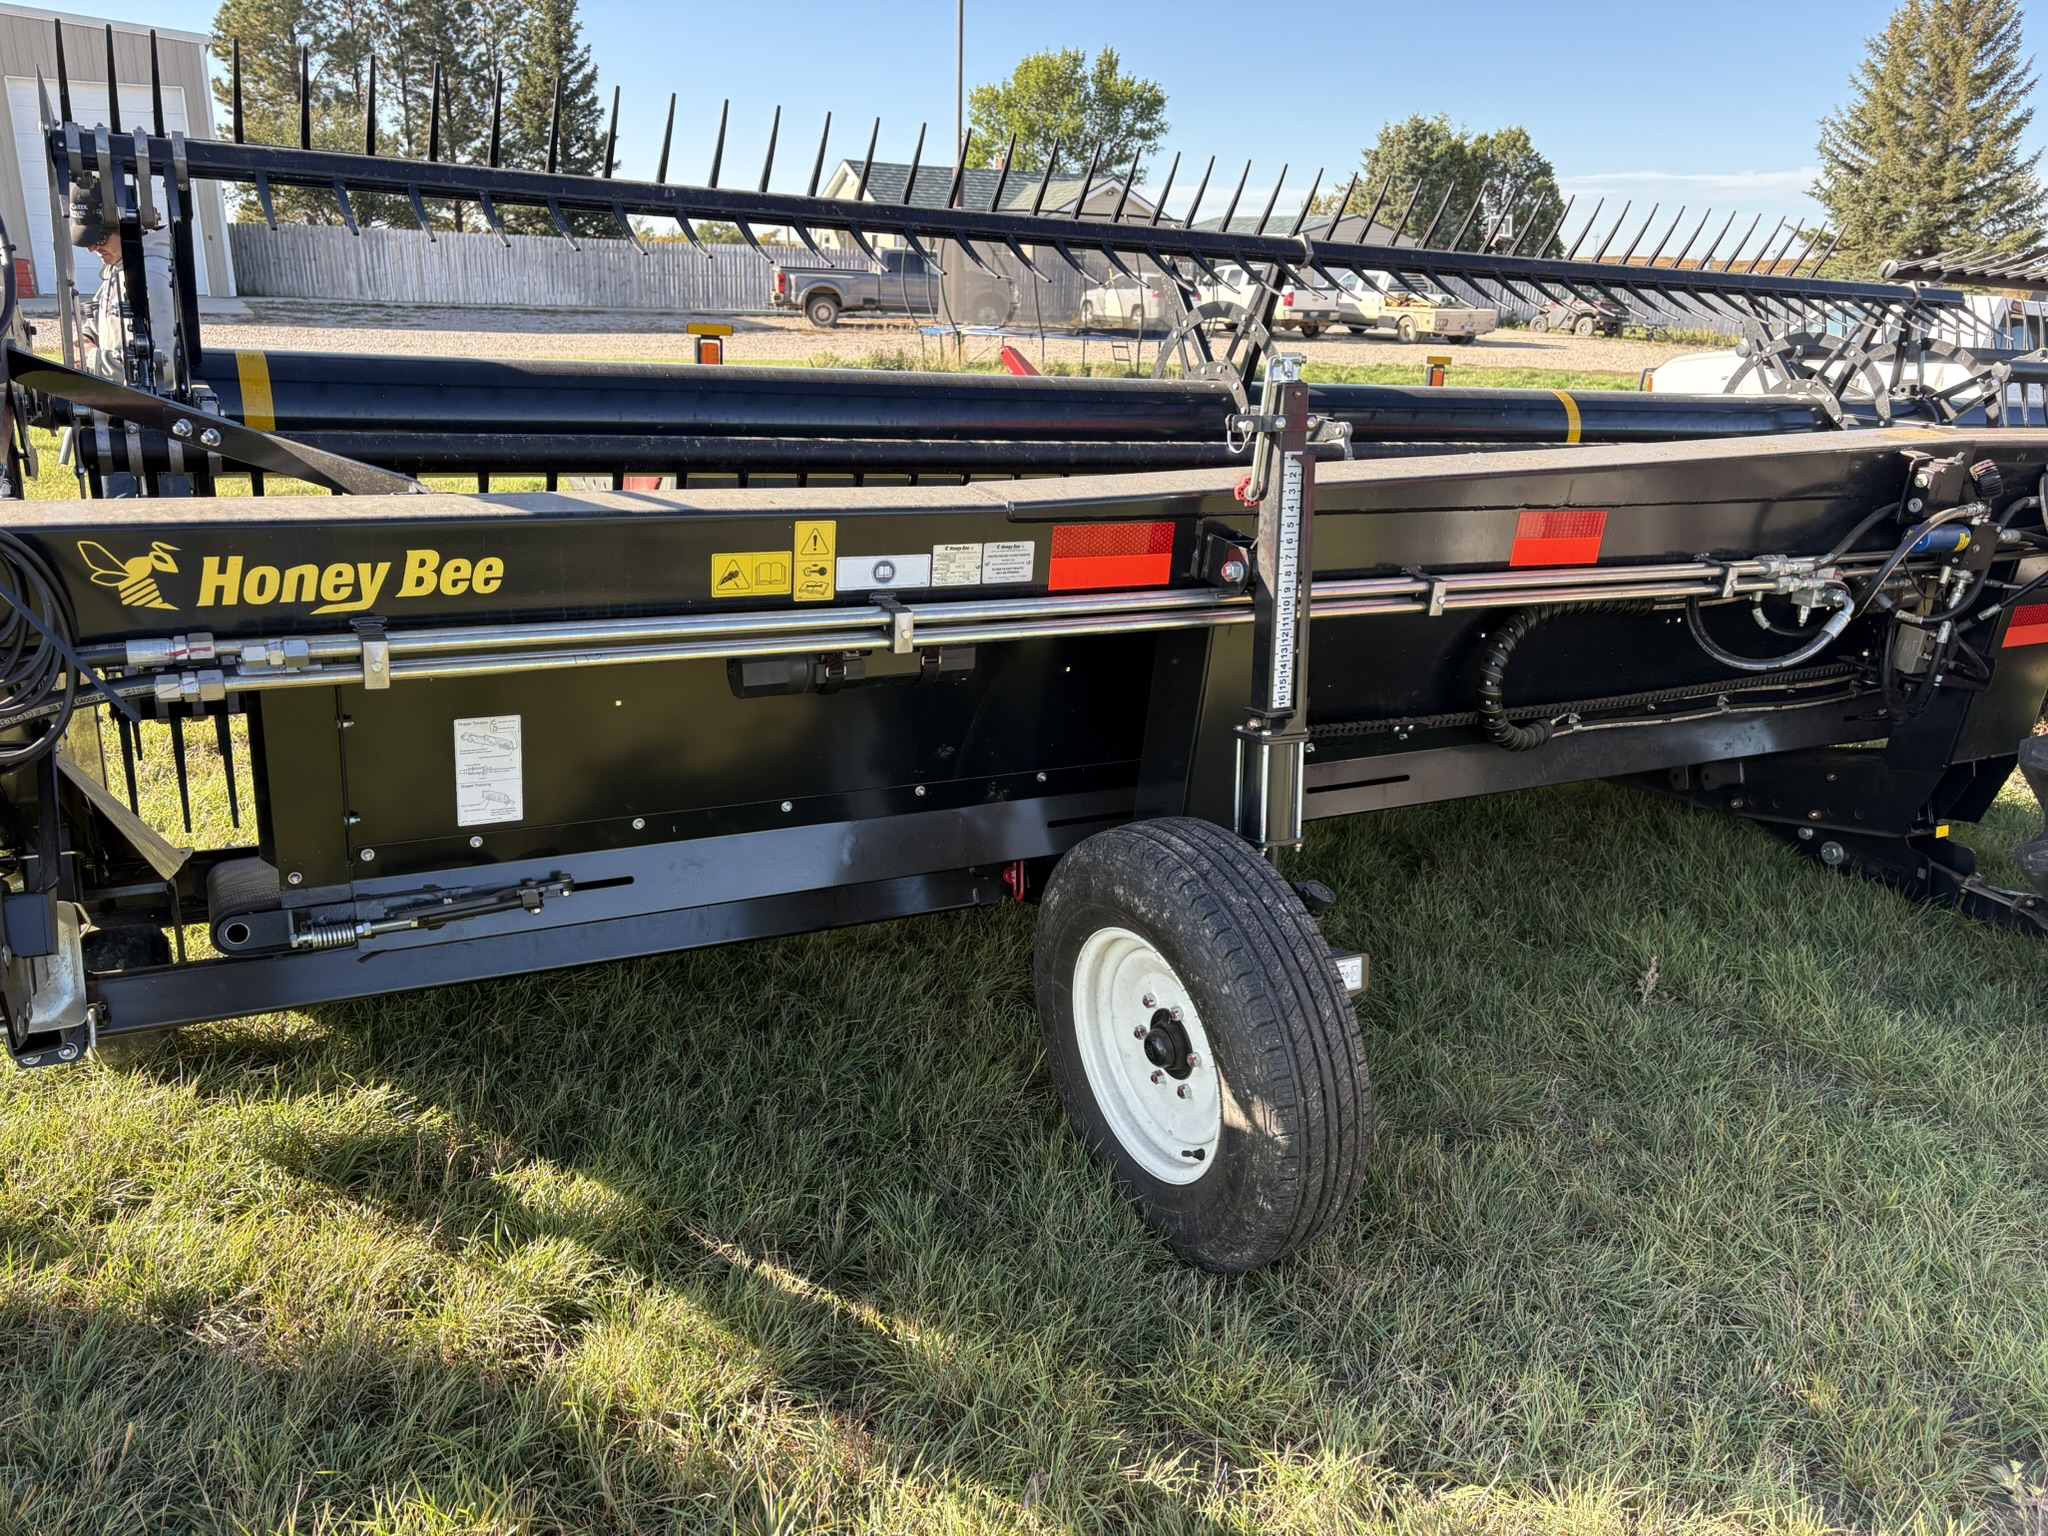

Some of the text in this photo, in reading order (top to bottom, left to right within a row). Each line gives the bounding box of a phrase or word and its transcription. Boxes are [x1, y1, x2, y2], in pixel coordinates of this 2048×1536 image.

[195, 548, 505, 615] Honey Bee
[1283, 600, 1290, 612] 10
[1282, 617, 1290, 627] 11
[1281, 632, 1289, 643] 12
[1280, 647, 1288, 659] 13
[1280, 663, 1287, 675] 14
[1279, 678, 1287, 690] 15
[77, 696, 97, 705] (4000
[1278, 694, 1286, 706] 16
